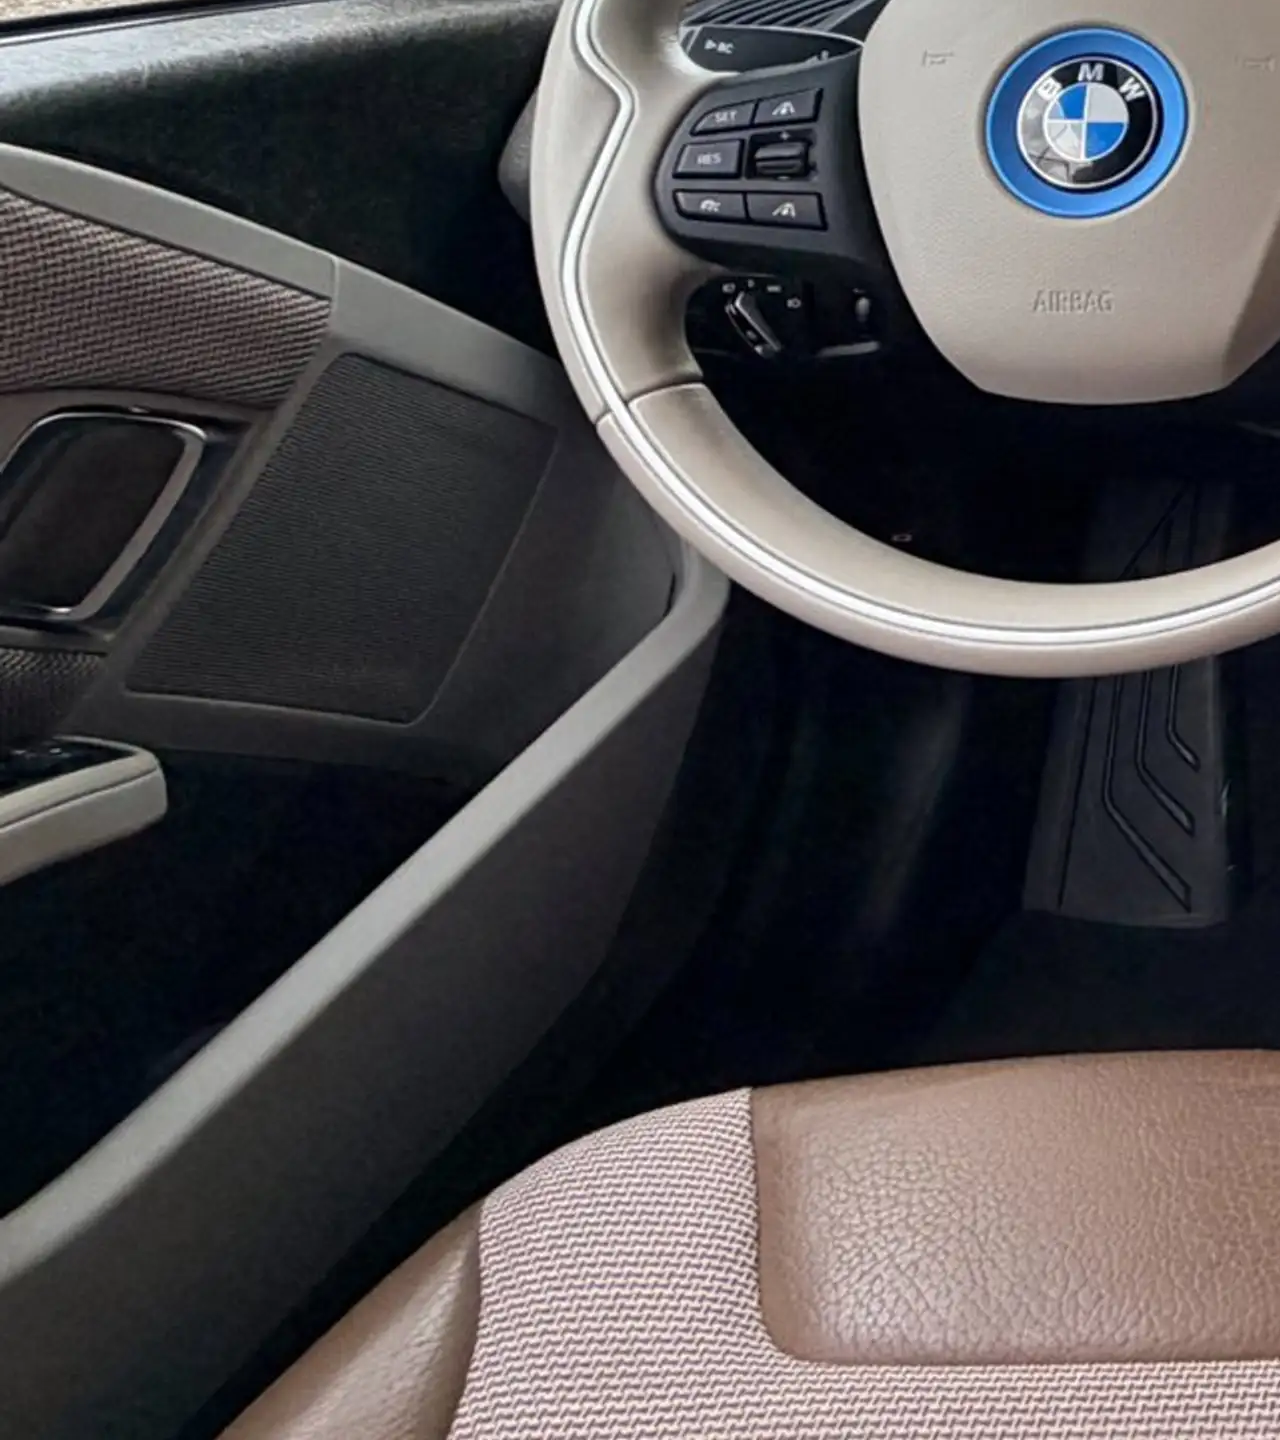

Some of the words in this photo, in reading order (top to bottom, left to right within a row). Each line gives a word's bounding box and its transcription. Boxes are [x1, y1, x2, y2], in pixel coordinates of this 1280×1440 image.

[1035, 62, 1146, 102] BMW
[714, 110, 738, 123] SET
[697, 152, 722, 165] RES
[1031, 289, 1115, 312] AIRBAG
